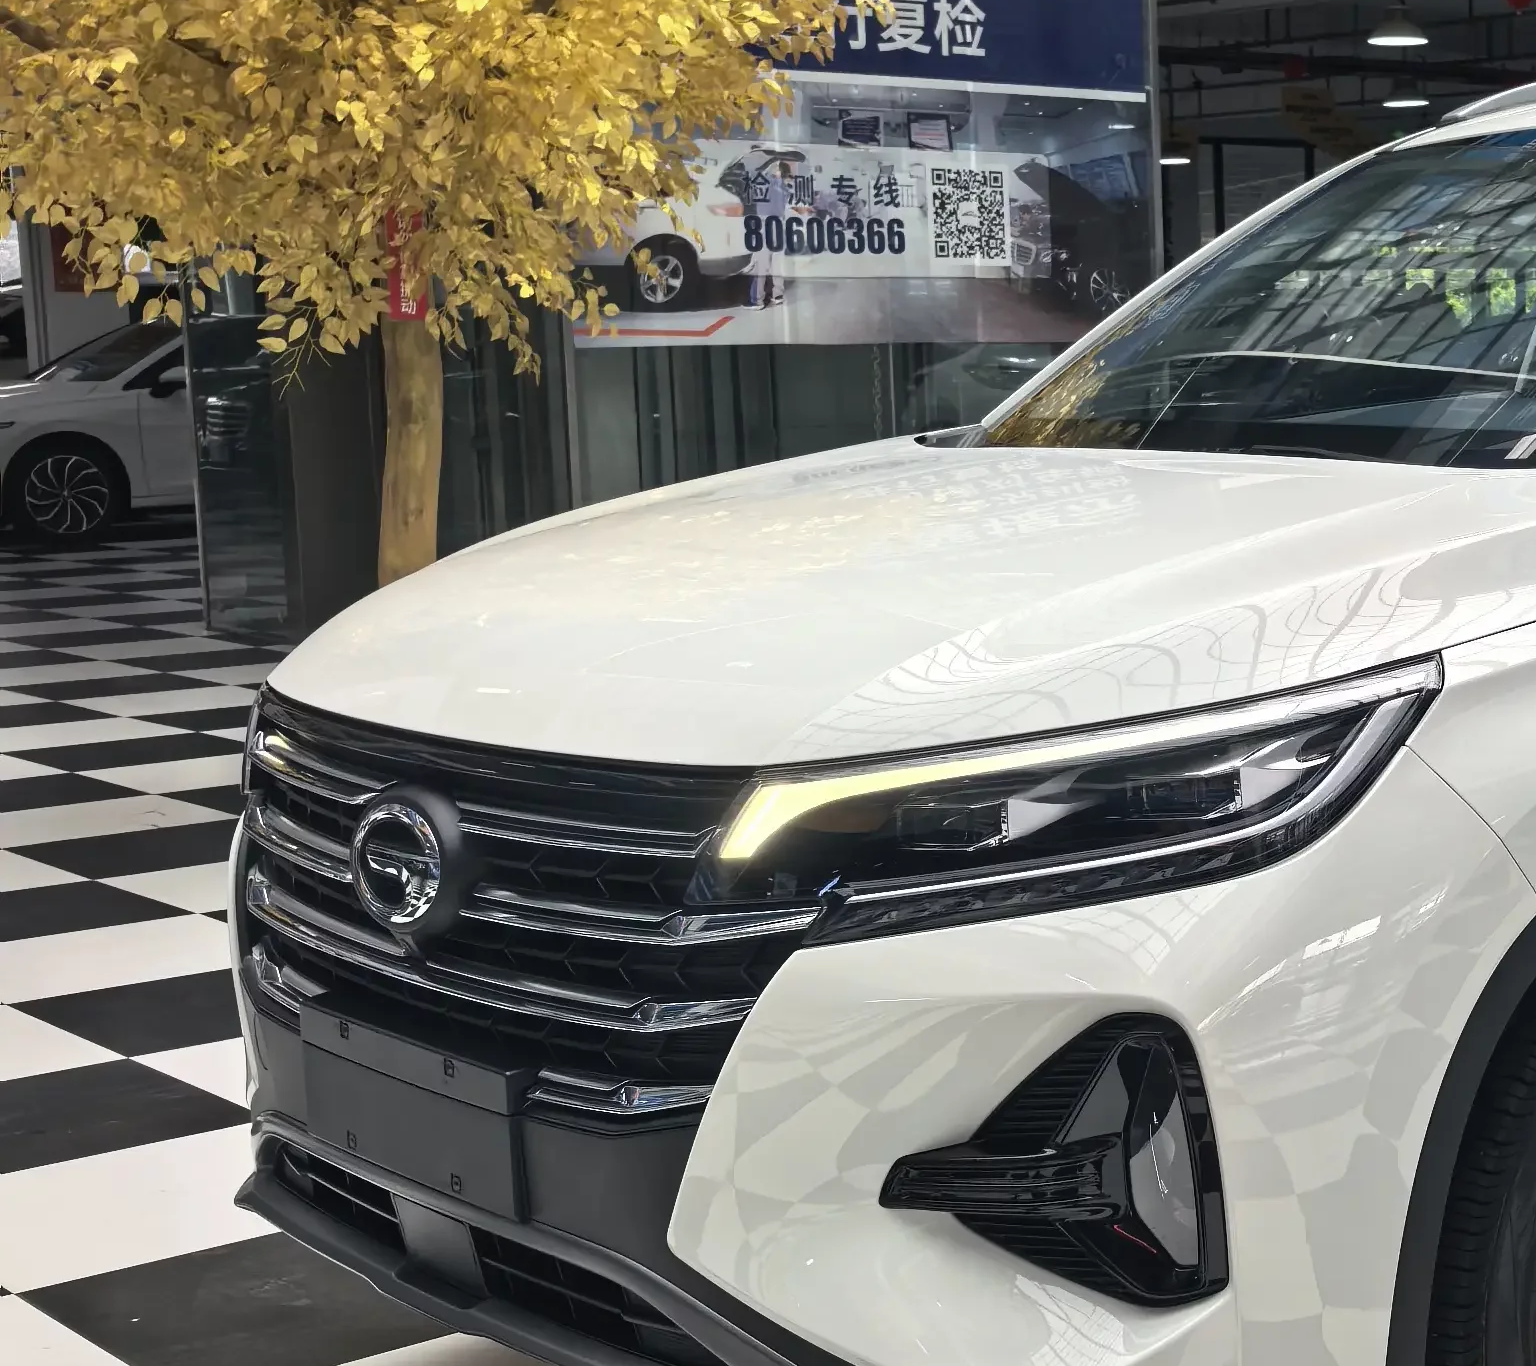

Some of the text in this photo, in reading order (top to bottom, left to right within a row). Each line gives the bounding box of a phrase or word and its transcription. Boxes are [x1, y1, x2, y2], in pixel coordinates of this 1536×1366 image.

[744, 171, 902, 209] 检测专线
[743, 215, 906, 255] 80606366
